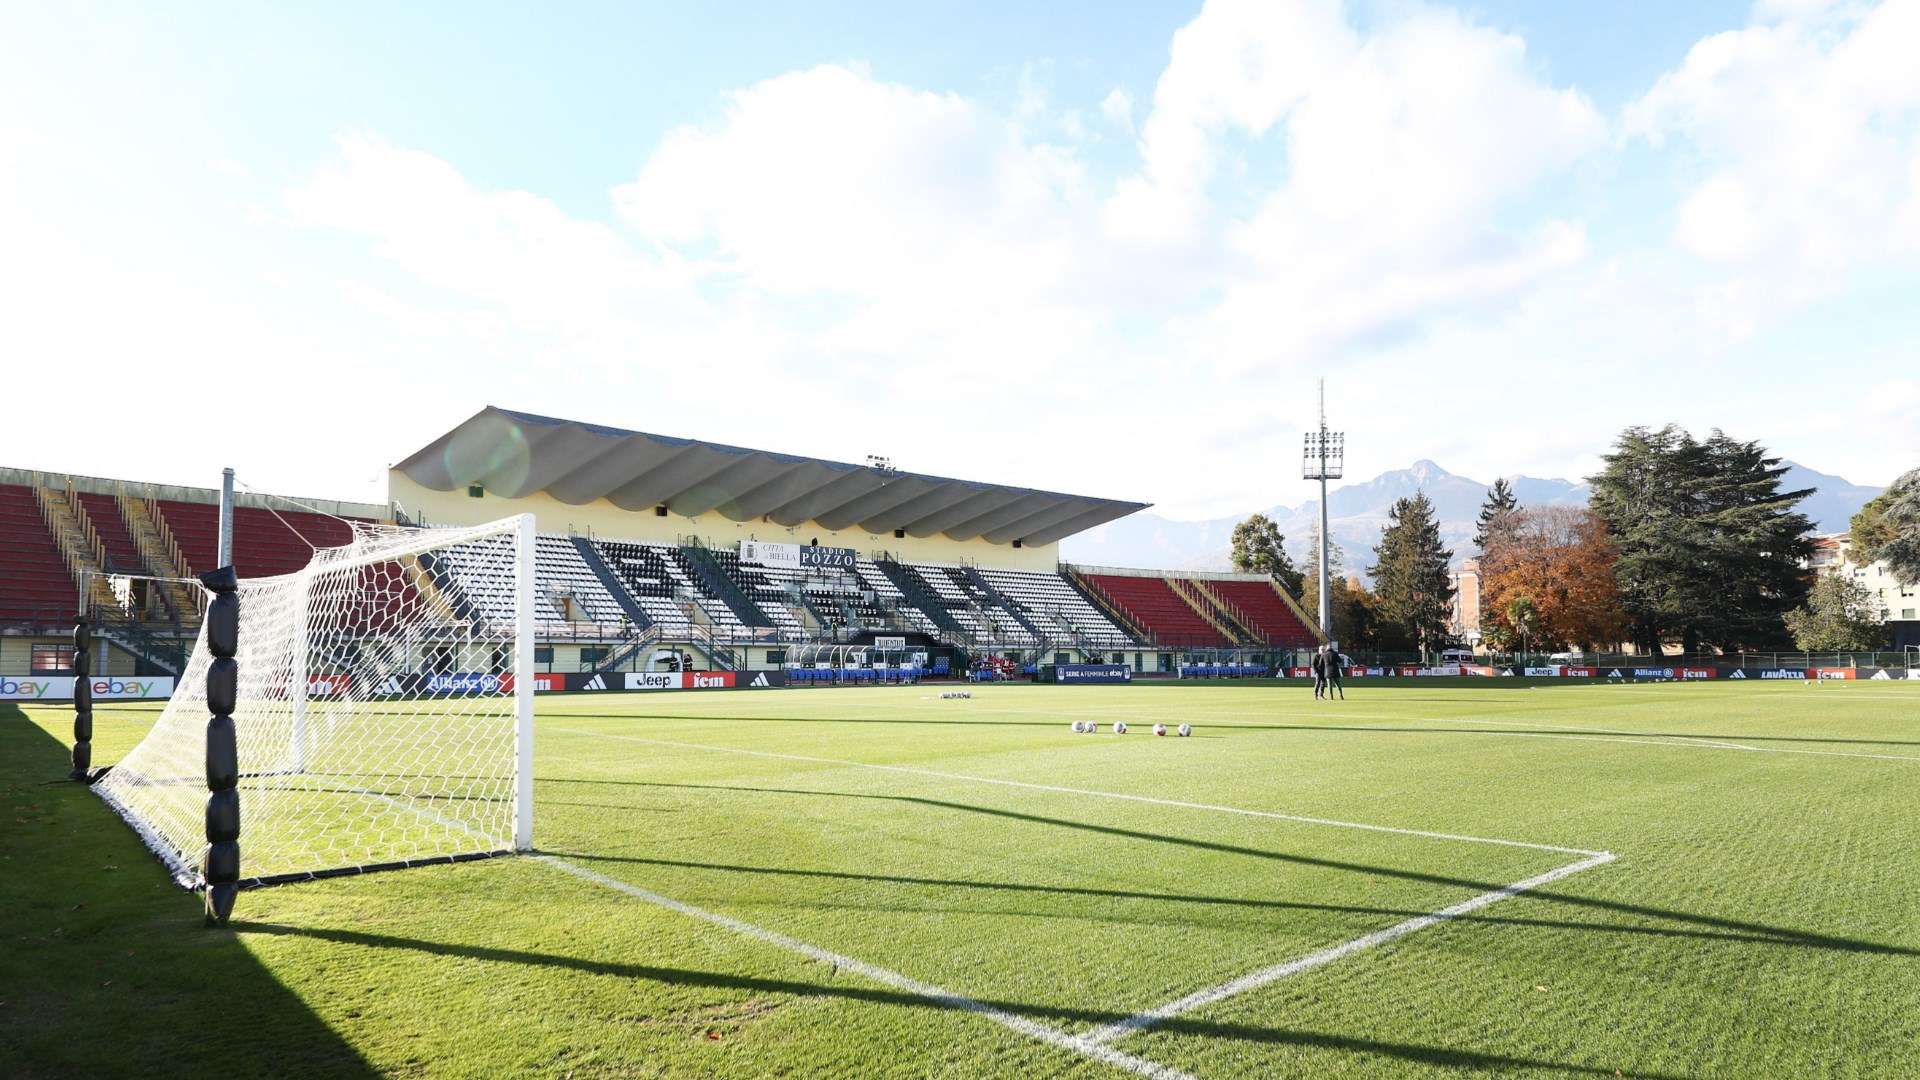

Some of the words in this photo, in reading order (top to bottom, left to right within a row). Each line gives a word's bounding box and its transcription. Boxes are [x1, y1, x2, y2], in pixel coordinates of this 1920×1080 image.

[809, 547, 845, 555] STADIO
[802, 553, 853, 566] POZZO
[1531, 668, 1553, 676] Jeep
[1634, 668, 1662, 676] Allianz
[636, 673, 671, 688] Jeep
[0, 678, 50, 698] bay
[93, 678, 153, 698] ebay
